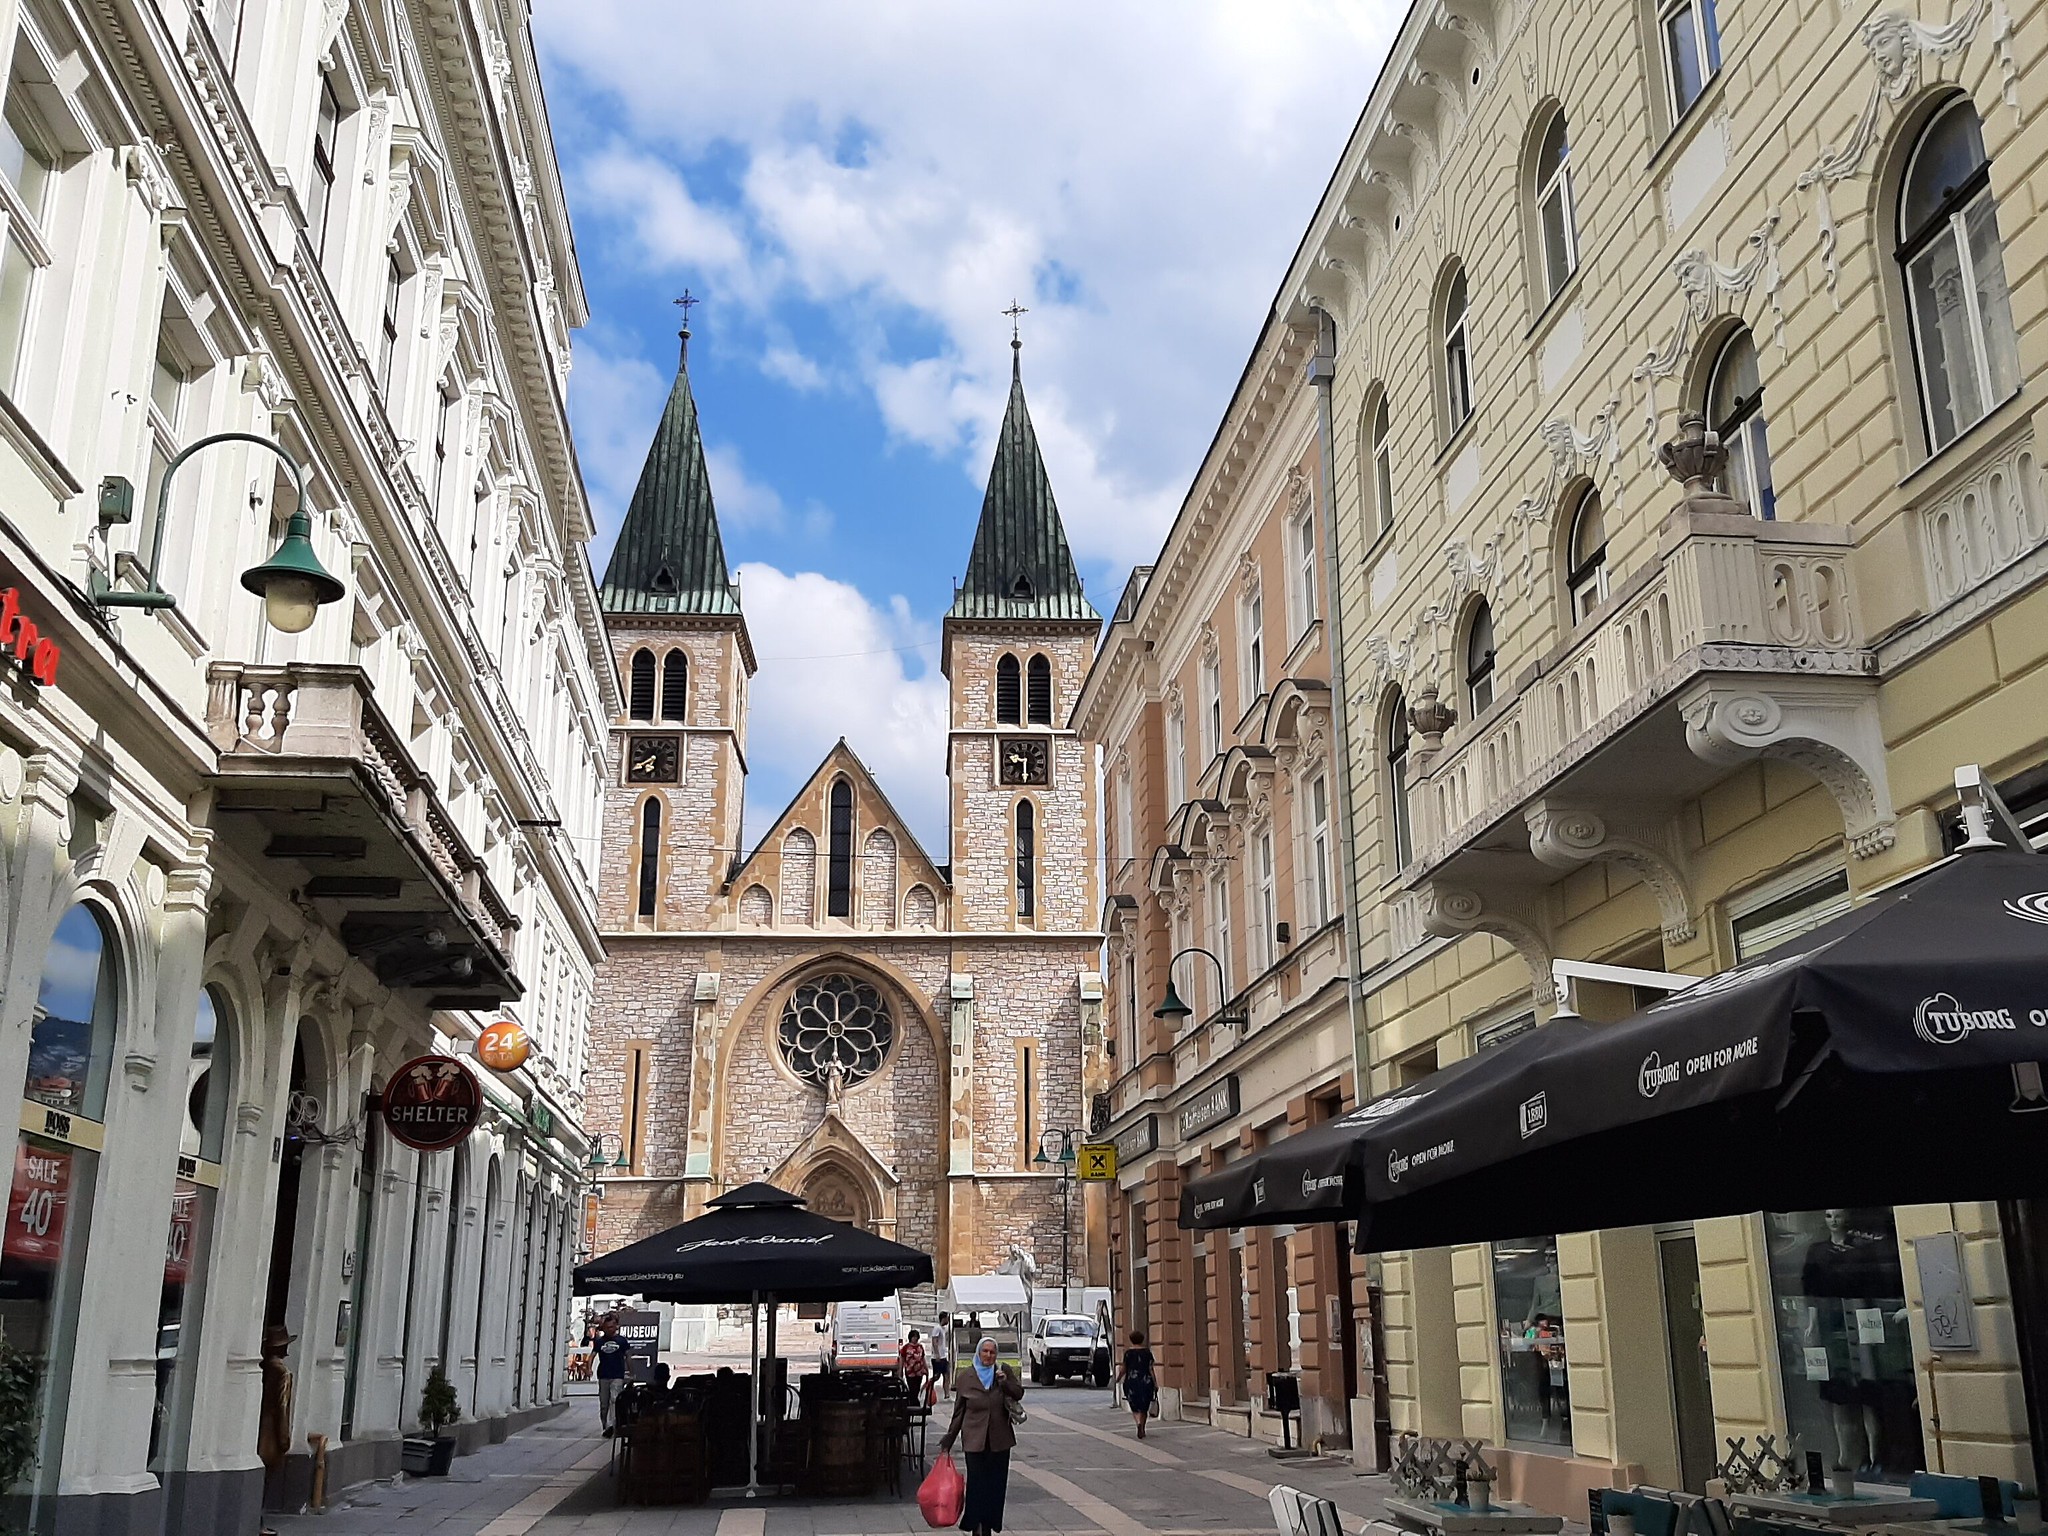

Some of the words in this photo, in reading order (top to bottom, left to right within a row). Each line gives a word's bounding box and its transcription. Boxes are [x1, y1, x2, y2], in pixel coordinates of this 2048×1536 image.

[1929, 1008, 2016, 1035] TUBORG
[485, 1032, 513, 1051] 24
[485, 1052, 514, 1062] SATA
[1644, 1061, 1680, 1089] TUBORG
[1686, 1056, 1712, 1076] OPEN
[1714, 1048, 1732, 1068] FOR
[1733, 1036, 1758, 1061] MORE
[1211, 1087, 1228, 1116] BANK
[1527, 1101, 1544, 1124] 1880
[45, 1109, 71, 1133] BOSS
[391, 1105, 469, 1123] SHELTER
[27, 1155, 61, 1184] SALE
[1411, 1150, 1426, 1167] OPEN
[20, 1187, 53, 1236] 40
[619, 1325, 659, 1339] MUSEUM
